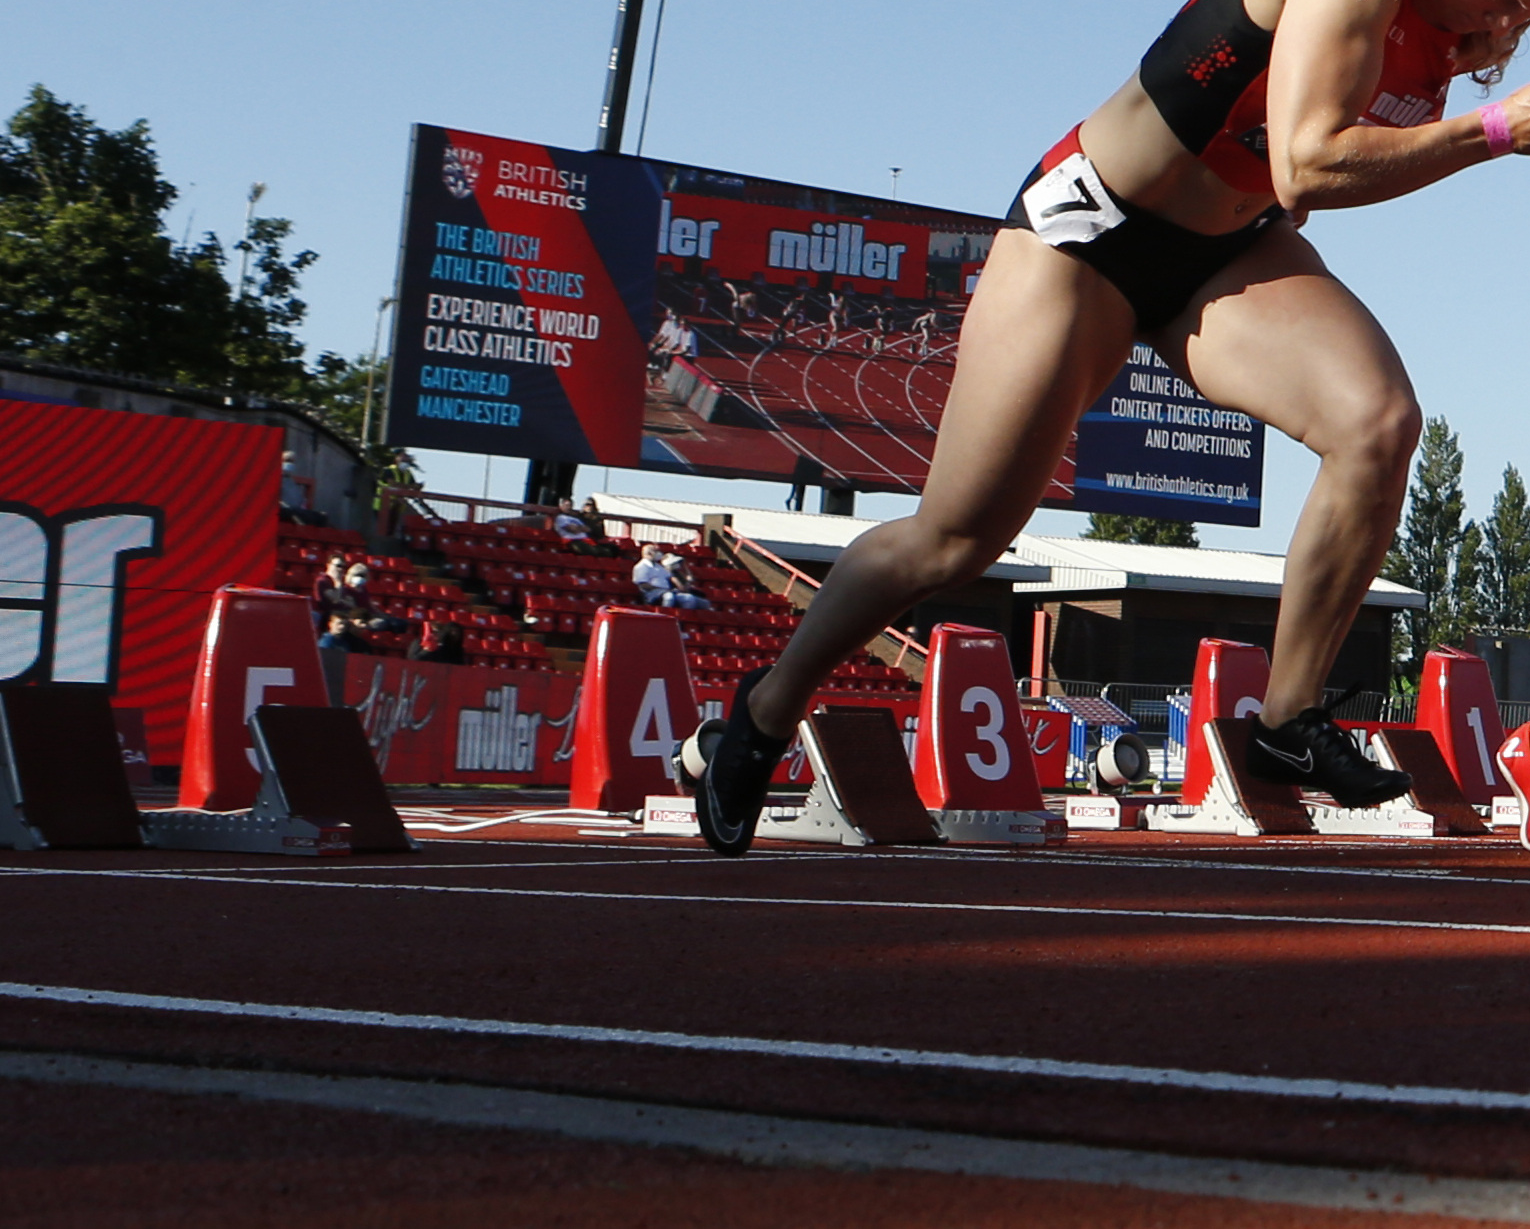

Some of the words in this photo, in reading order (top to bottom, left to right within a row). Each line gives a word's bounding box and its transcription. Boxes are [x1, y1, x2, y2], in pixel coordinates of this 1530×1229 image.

[498, 160, 587, 192] BRITISH
[494, 184, 587, 211] ATHLETICS
[1041, 177, 1102, 218] 7
[435, 222, 469, 251] THE
[472, 227, 540, 261] BRITISH
[768, 222, 906, 281] müller
[430, 253, 523, 290] ATHLETICS
[526, 267, 585, 299] SERIES
[427, 293, 536, 333] EXPERIENCE
[539, 308, 600, 340] WORLD
[424, 325, 479, 357] CLASS
[481, 333, 573, 367] ATHLETICS
[420, 365, 510, 397] GATESHEAD
[1130, 373, 1171, 396] ONLINE
[417, 394, 521, 427] MANCHESTER
[1111, 397, 1163, 423] CONTENT,
[1167, 403, 1211, 428] TICKETS
[1212, 410, 1252, 432] OFFERS
[1145, 428, 1169, 449] AND
[1172, 431, 1251, 459] COMPETITIONS
[1106, 471, 1249, 503] www.britishathletics.org.uk
[456, 685, 543, 771] müller
[629, 678, 683, 779] 4
[960, 686, 1011, 782] 3
[1466, 707, 1496, 786] 1
[663, 812, 692, 823] OMEGA
[1084, 807, 1111, 817] OMEGA
